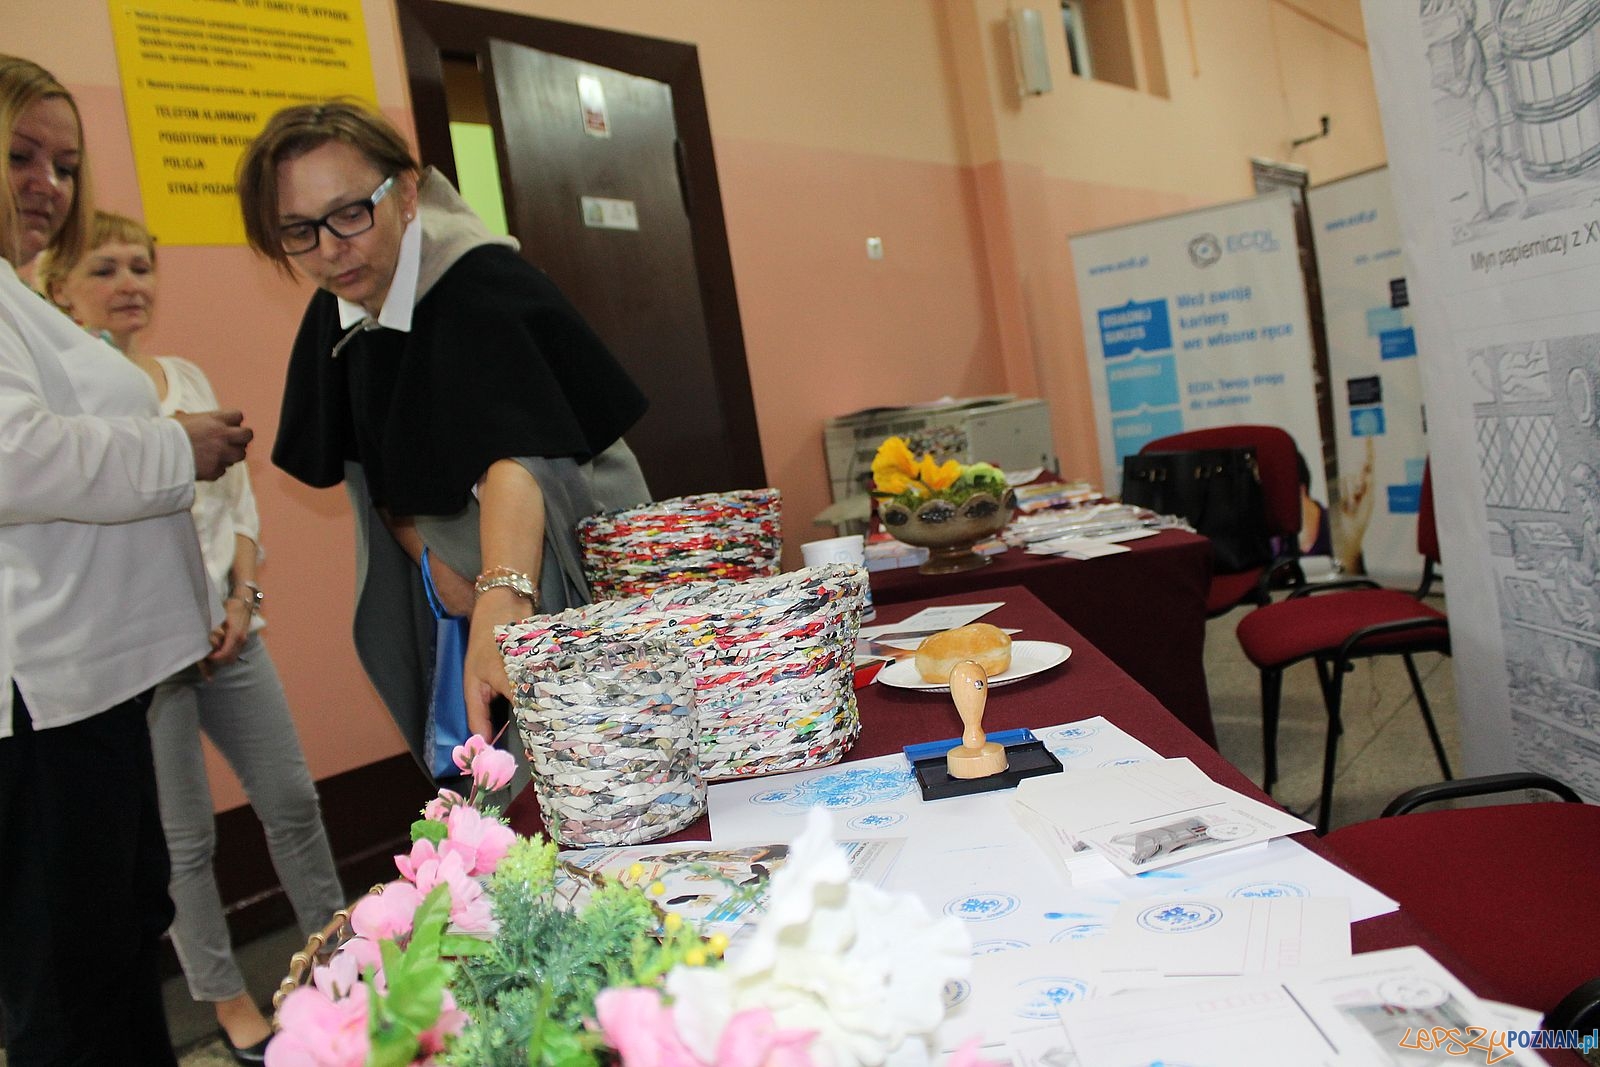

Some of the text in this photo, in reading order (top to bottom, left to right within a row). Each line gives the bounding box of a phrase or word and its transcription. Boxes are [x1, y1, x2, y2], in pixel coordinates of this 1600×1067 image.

[155, 104, 256, 123] TELEFON ALARMOWY
[158, 131, 218, 145] POGOTOWIE
[163, 156, 204, 170] POLICJA
[1470, 250, 1497, 273] Młyn
[1498, 234, 1568, 268] papierniczy
[1571, 229, 1582, 247] z
